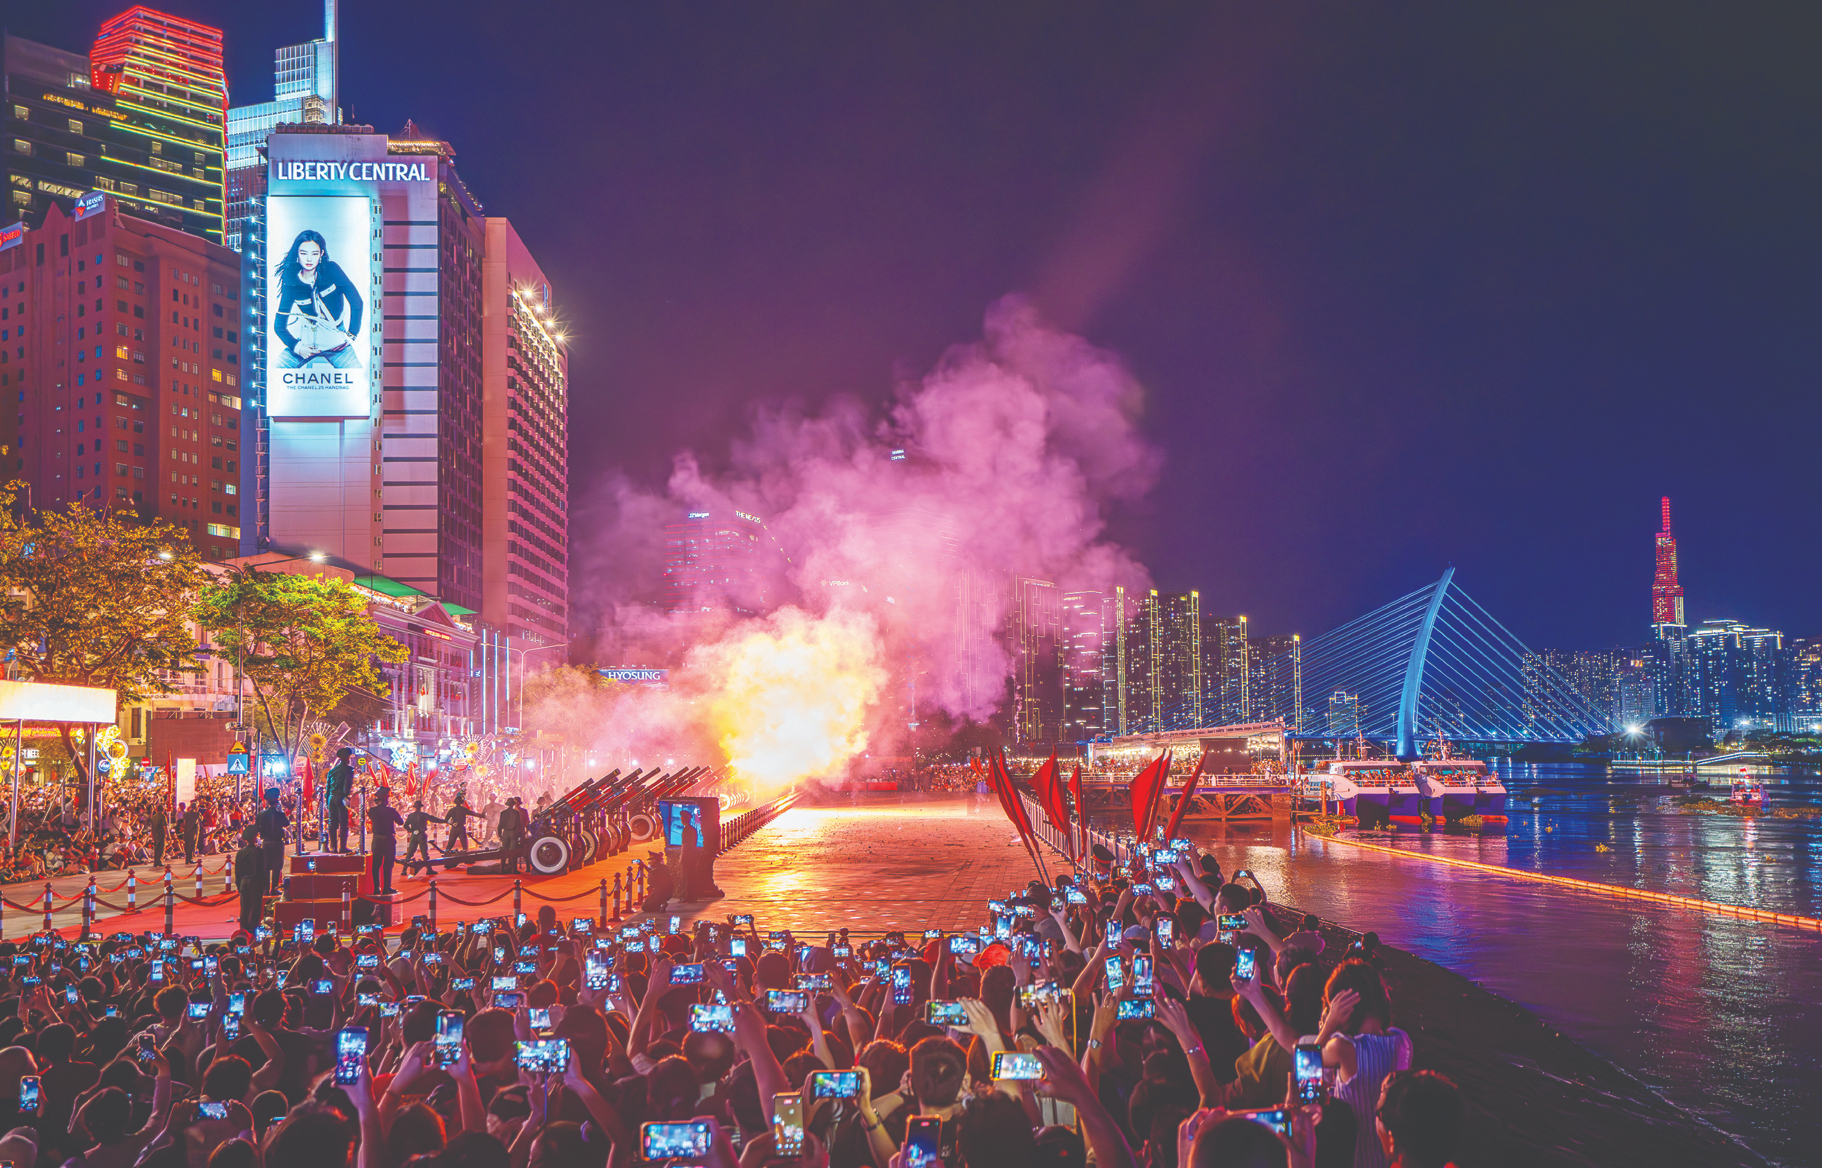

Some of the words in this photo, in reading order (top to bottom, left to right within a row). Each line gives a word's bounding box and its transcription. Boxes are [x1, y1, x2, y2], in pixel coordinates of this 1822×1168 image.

[278, 162, 347, 180] LIBERTY
[349, 162, 430, 181] CENTRAL
[282, 373, 354, 384] CHANEL
[607, 671, 661, 681] HYOSUNG
